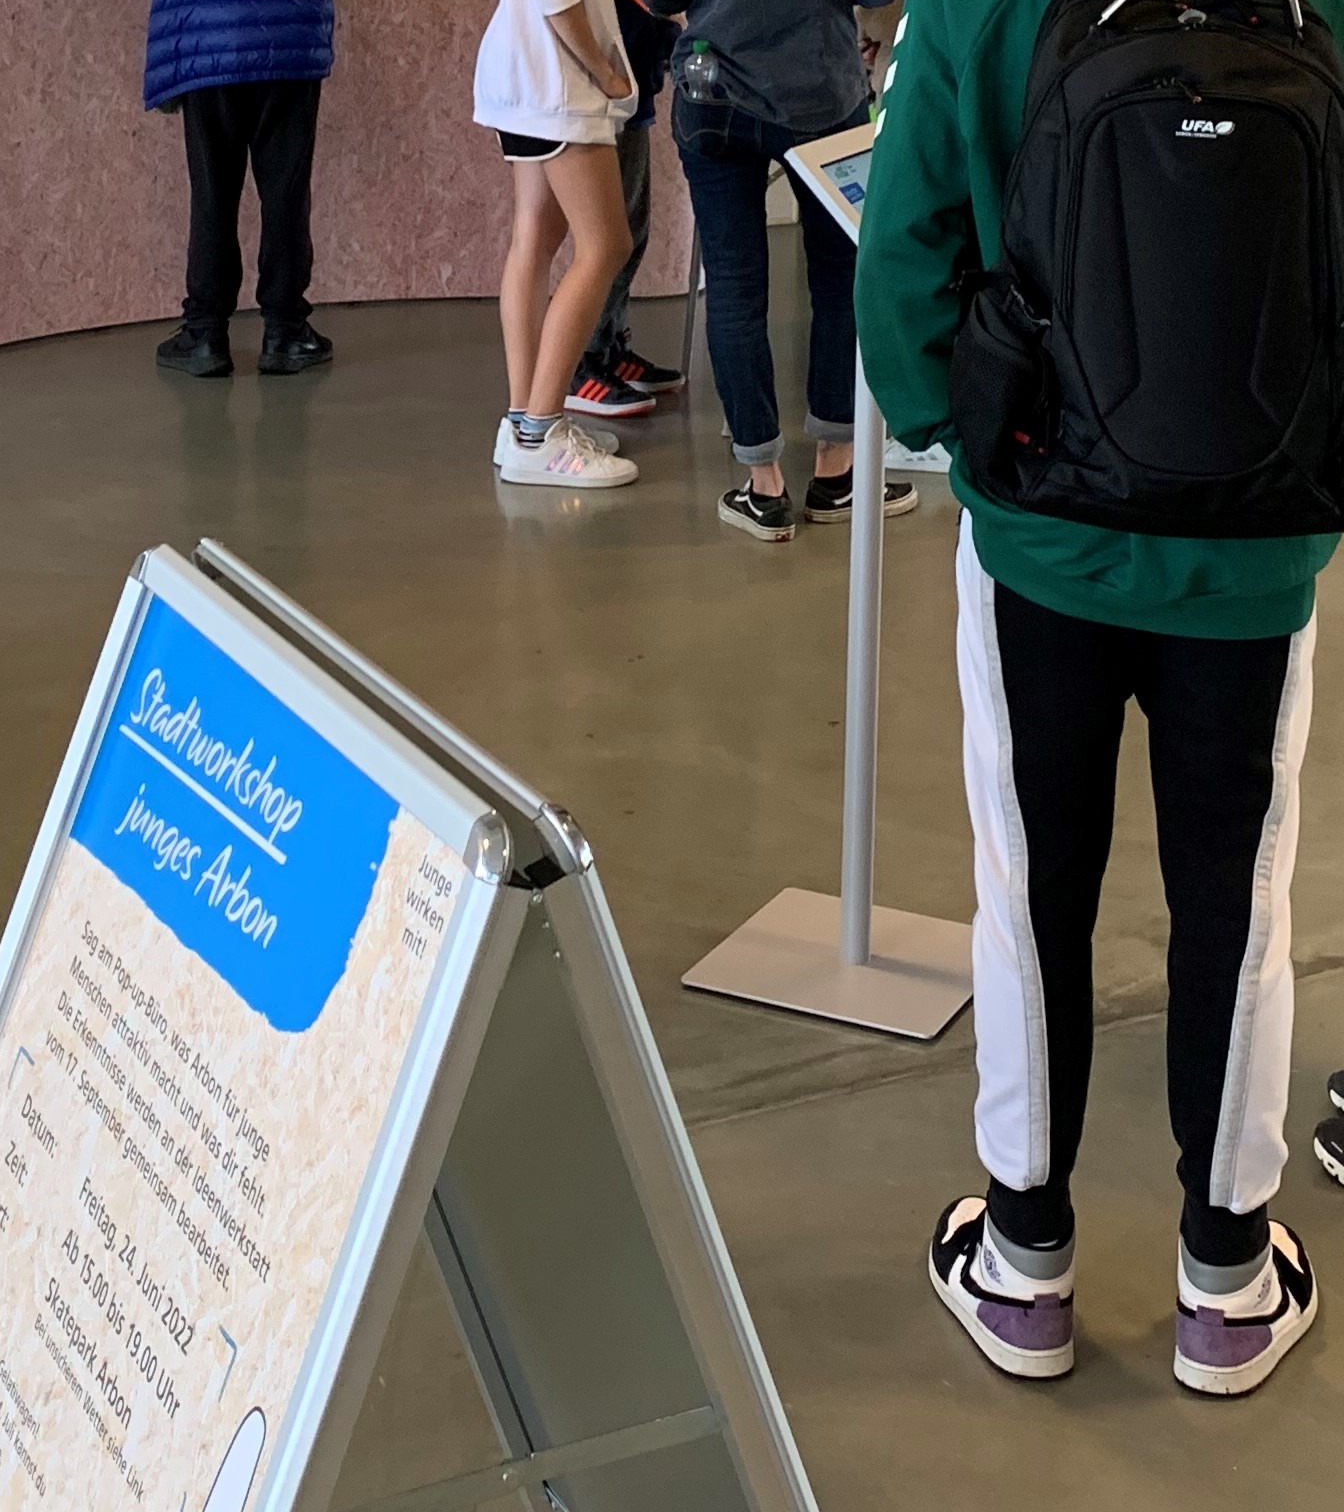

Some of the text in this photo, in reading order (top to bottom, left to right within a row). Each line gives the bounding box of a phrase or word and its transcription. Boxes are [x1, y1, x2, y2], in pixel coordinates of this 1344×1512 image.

[1181, 119, 1215, 133] UFA
[129, 667, 303, 844] Stadtworkshop
[114, 783, 279, 949] junges Arbon
[402, 926, 427, 960] mit!
[406, 887, 444, 935] wirken
[418, 853, 452, 898] Junge
[69, 955, 266, 1218] Menschen attraktiv macht und was dir fehlt.
[81, 920, 270, 1163] Sag am Pop-up-Büro, was Arbon für junge
[4, 1139, 29, 1188] Zeit:
[21, 1092, 58, 1160] Datum:
[45, 1029, 231, 1293] vom 17. September gemeinsam bearbeitet.
[56, 990, 271, 1284] Die Erkenntnisse werden an der Ideenwerkstatt
[61, 1229, 181, 1419] Ab 15.00 bis 19.00 Uhr
[78, 1175, 195, 1357] Freitag, 24. Juni 2022
[33, 1312, 146, 1504] Bei unsicherem Wetter siehe Link
[44, 1276, 132, 1431] Skatepark Arbon
[1, 1412, 17, 1441] Juli
[13, 1432, 39, 1481] kannst
[35, 1474, 48, 1498] du
